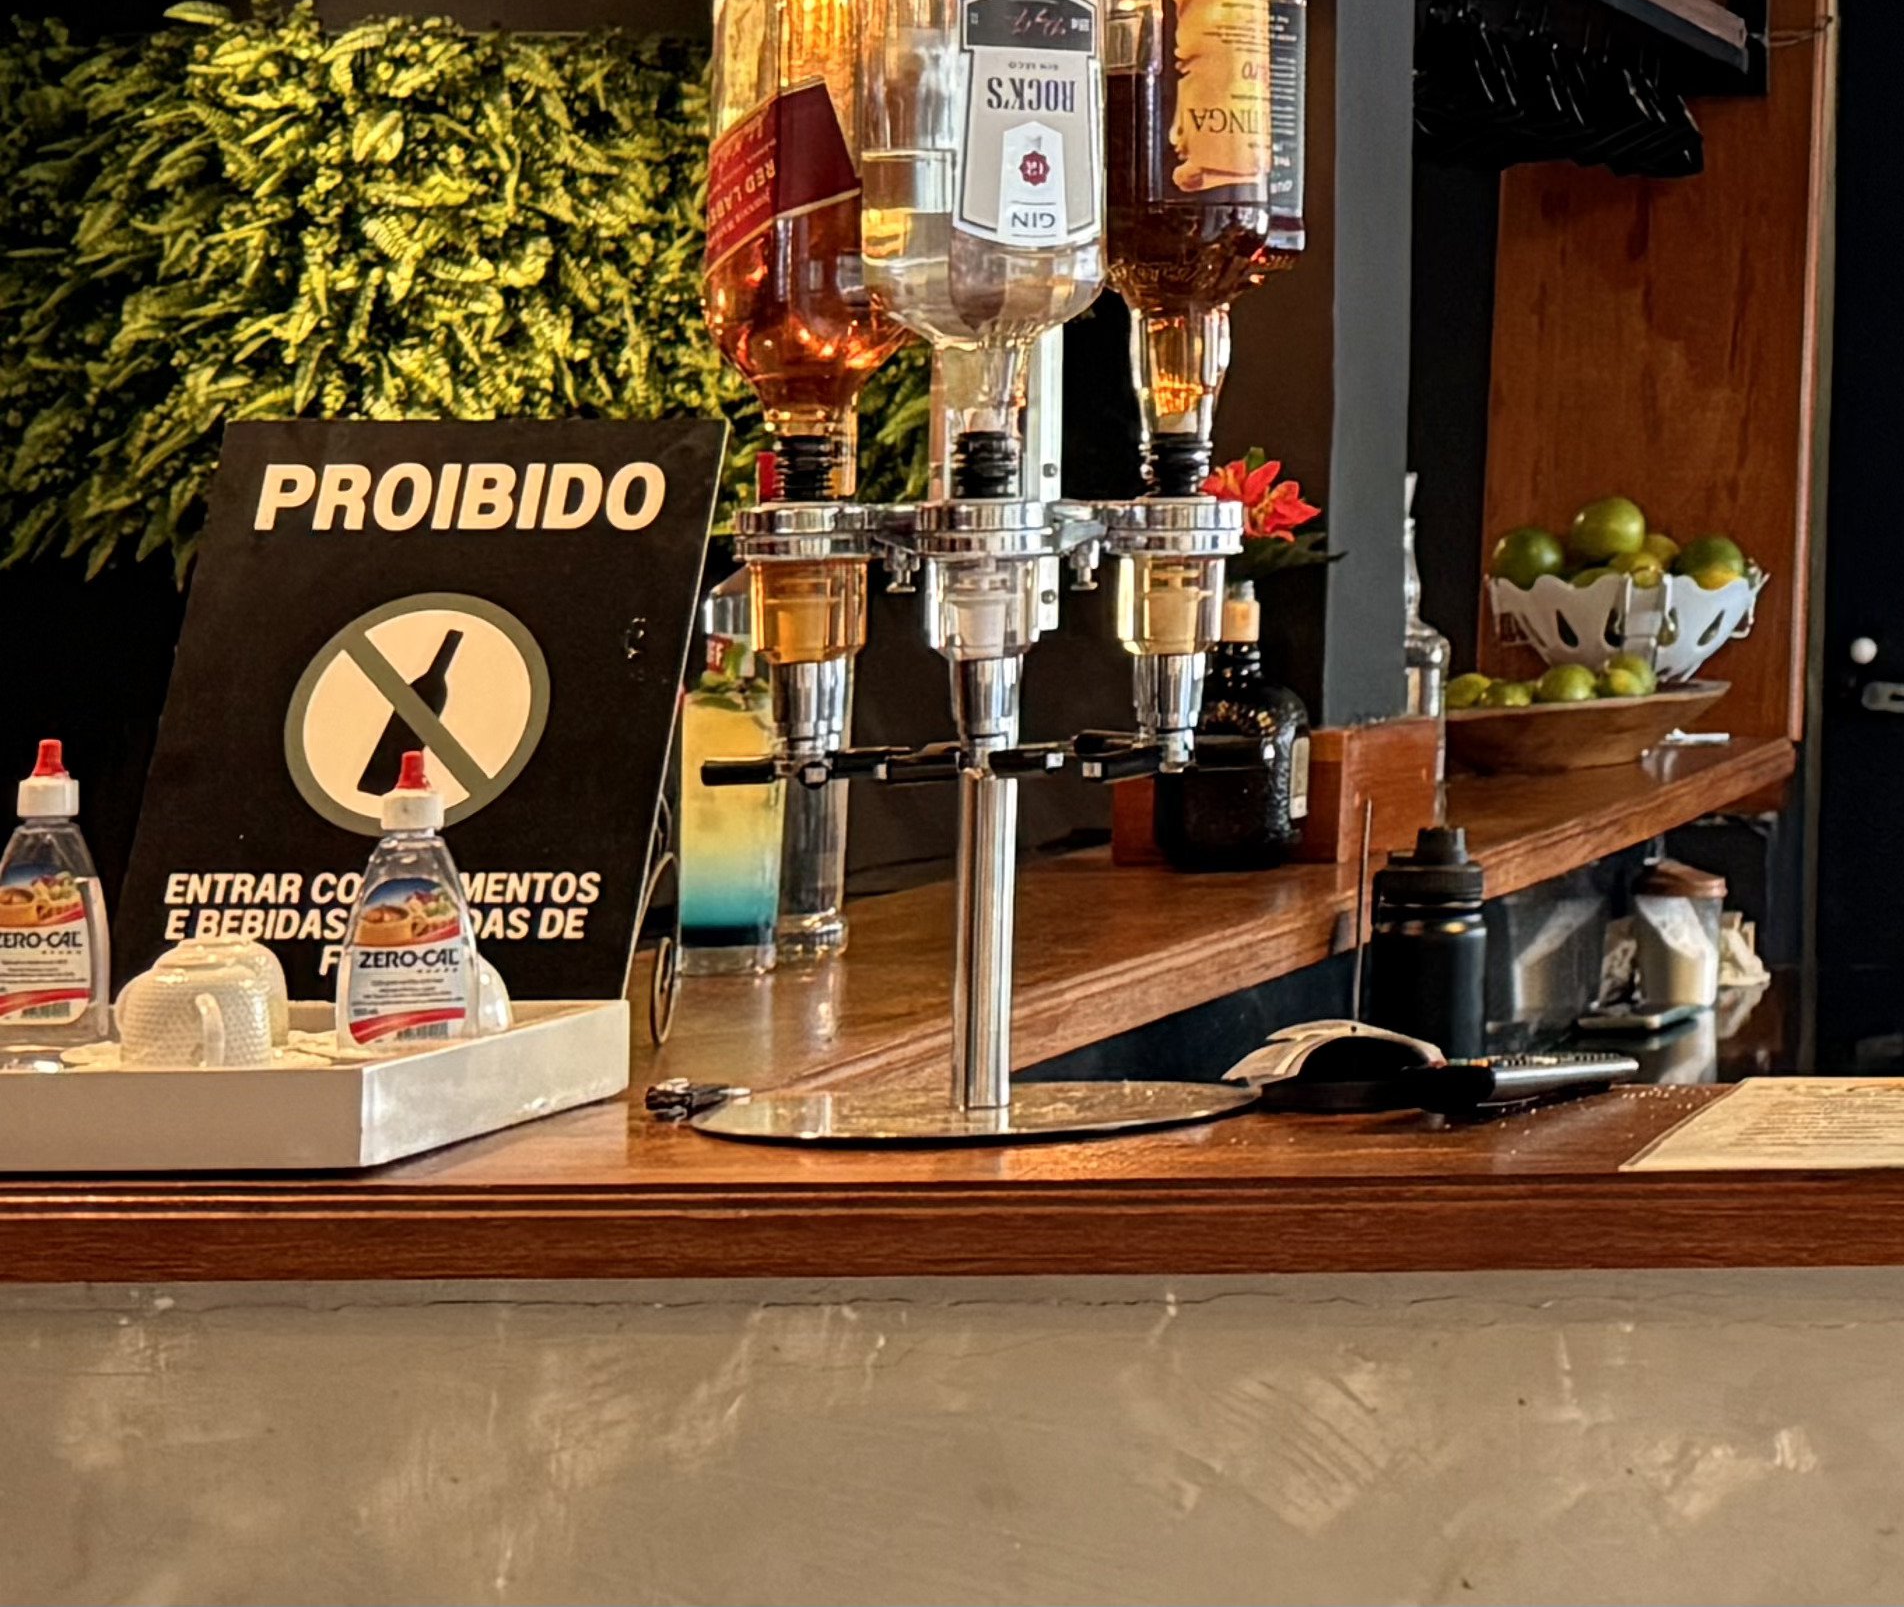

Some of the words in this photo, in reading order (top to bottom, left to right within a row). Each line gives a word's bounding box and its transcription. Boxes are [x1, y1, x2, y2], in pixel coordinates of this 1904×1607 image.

[986, 76, 1077, 114] ROCK'S
[1011, 211, 1057, 229] GIN
[253, 462, 666, 531] PROIBIDO
[163, 872, 302, 905] ENTRAR
[310, 872, 364, 905] CO
[459, 871, 602, 905] MENTOS
[164, 909, 191, 941] E
[194, 907, 348, 941] BEBIDAS
[473, 907, 532, 940] DAS
[537, 907, 590, 940] DE
[358, 948, 460, 969] ZERO-CAL
